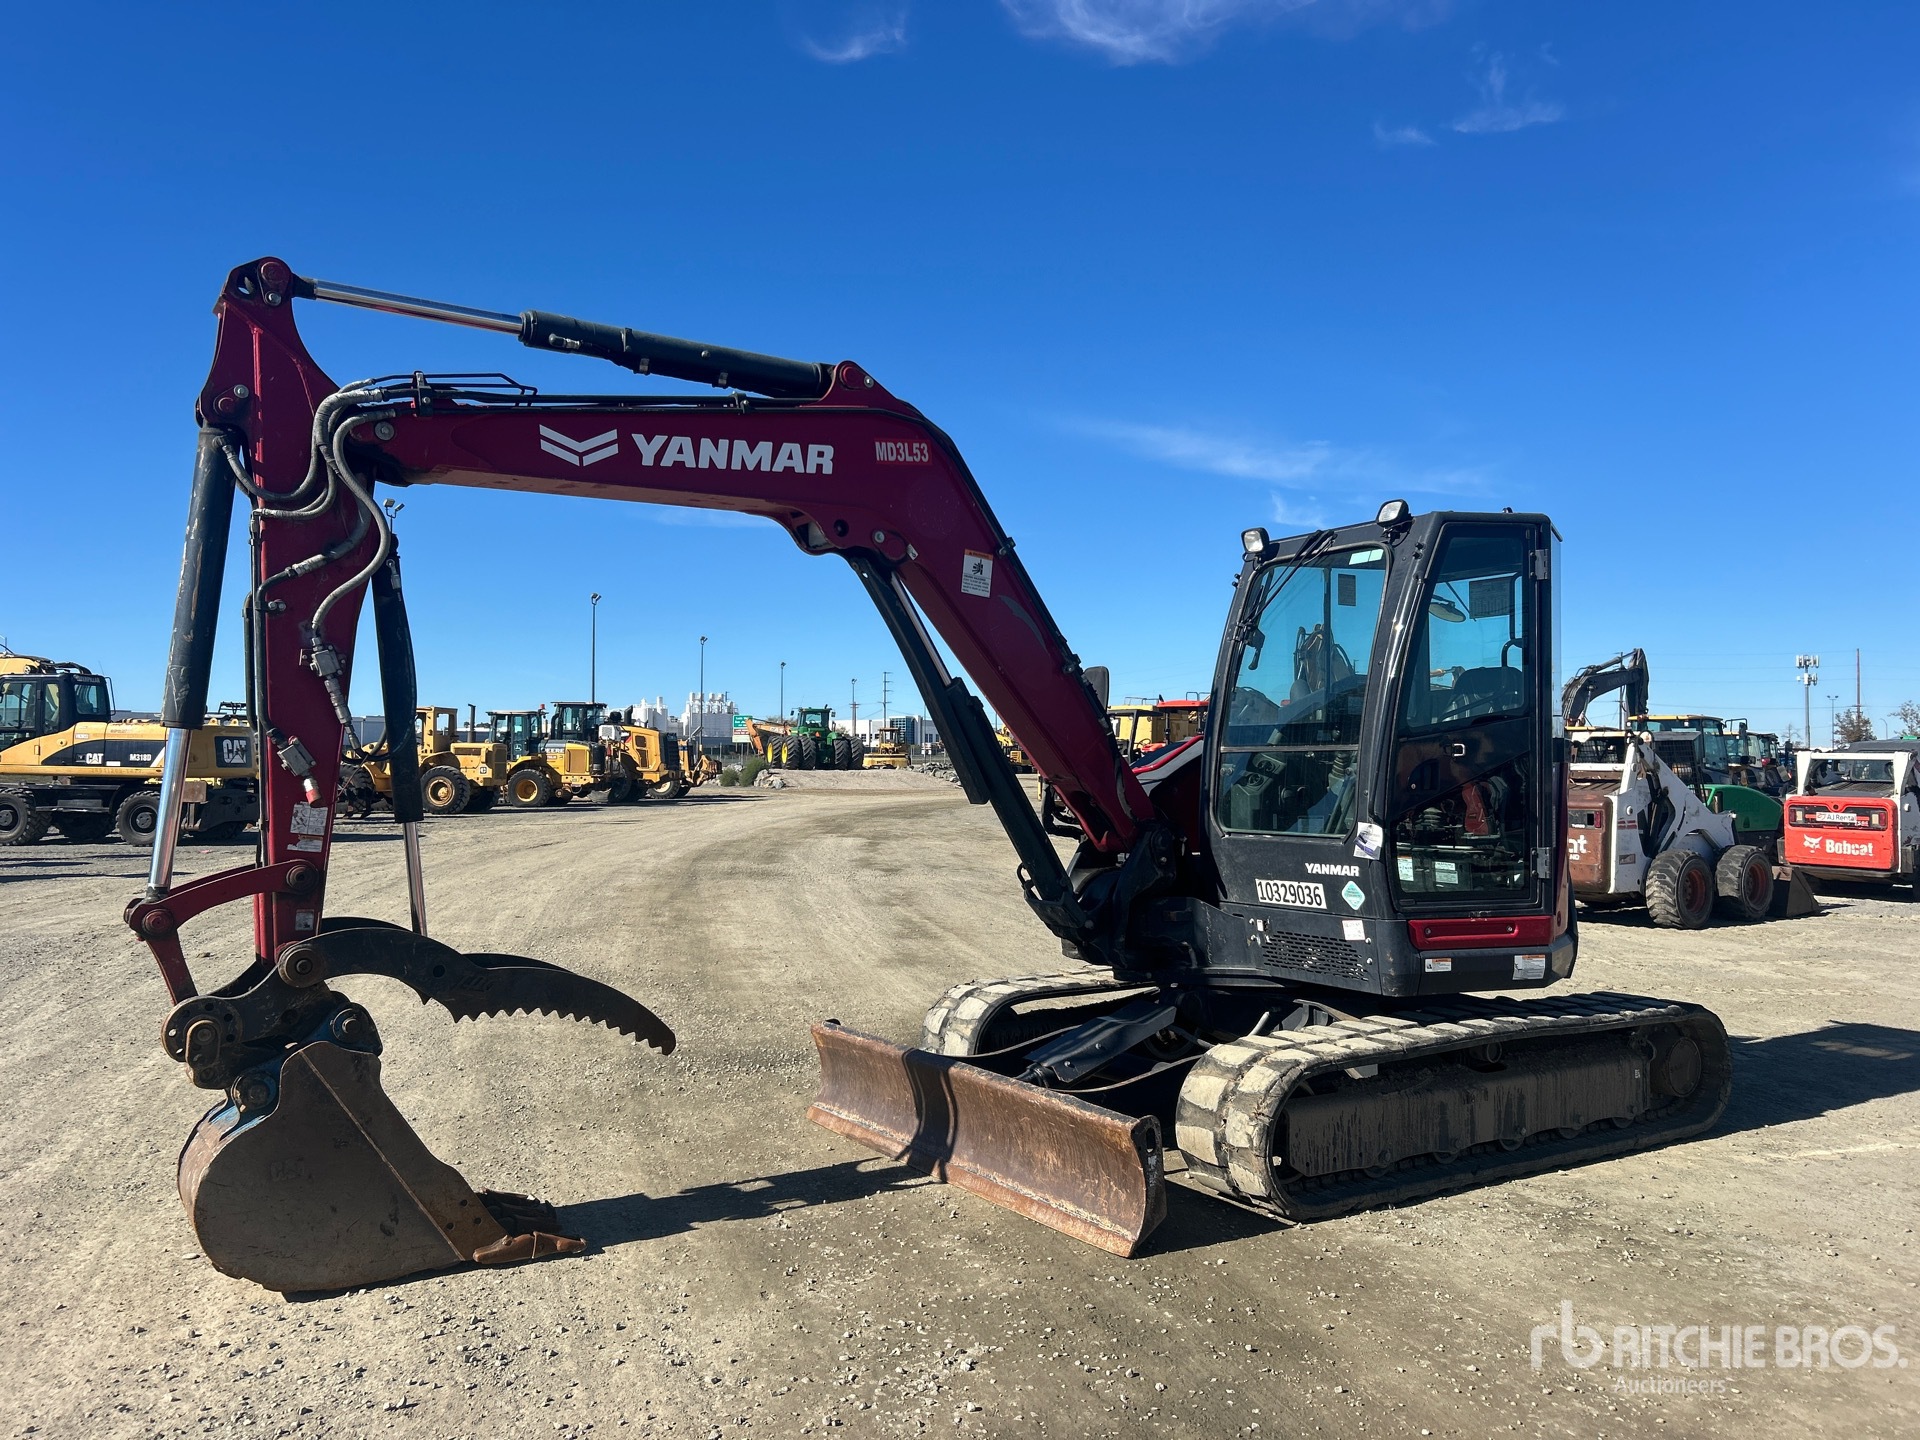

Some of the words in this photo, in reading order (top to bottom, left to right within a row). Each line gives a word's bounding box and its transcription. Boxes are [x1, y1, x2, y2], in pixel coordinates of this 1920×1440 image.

[631, 433, 834, 474] YANMAR
[875, 441, 929, 462] MD3L53
[86, 753, 104, 764] CAT
[129, 753, 152, 762] M318D
[222, 739, 247, 764] CAT
[1826, 839, 1873, 856] Bobcat
[1305, 862, 1360, 877] YANMAR
[1258, 881, 1322, 906] 10329036
